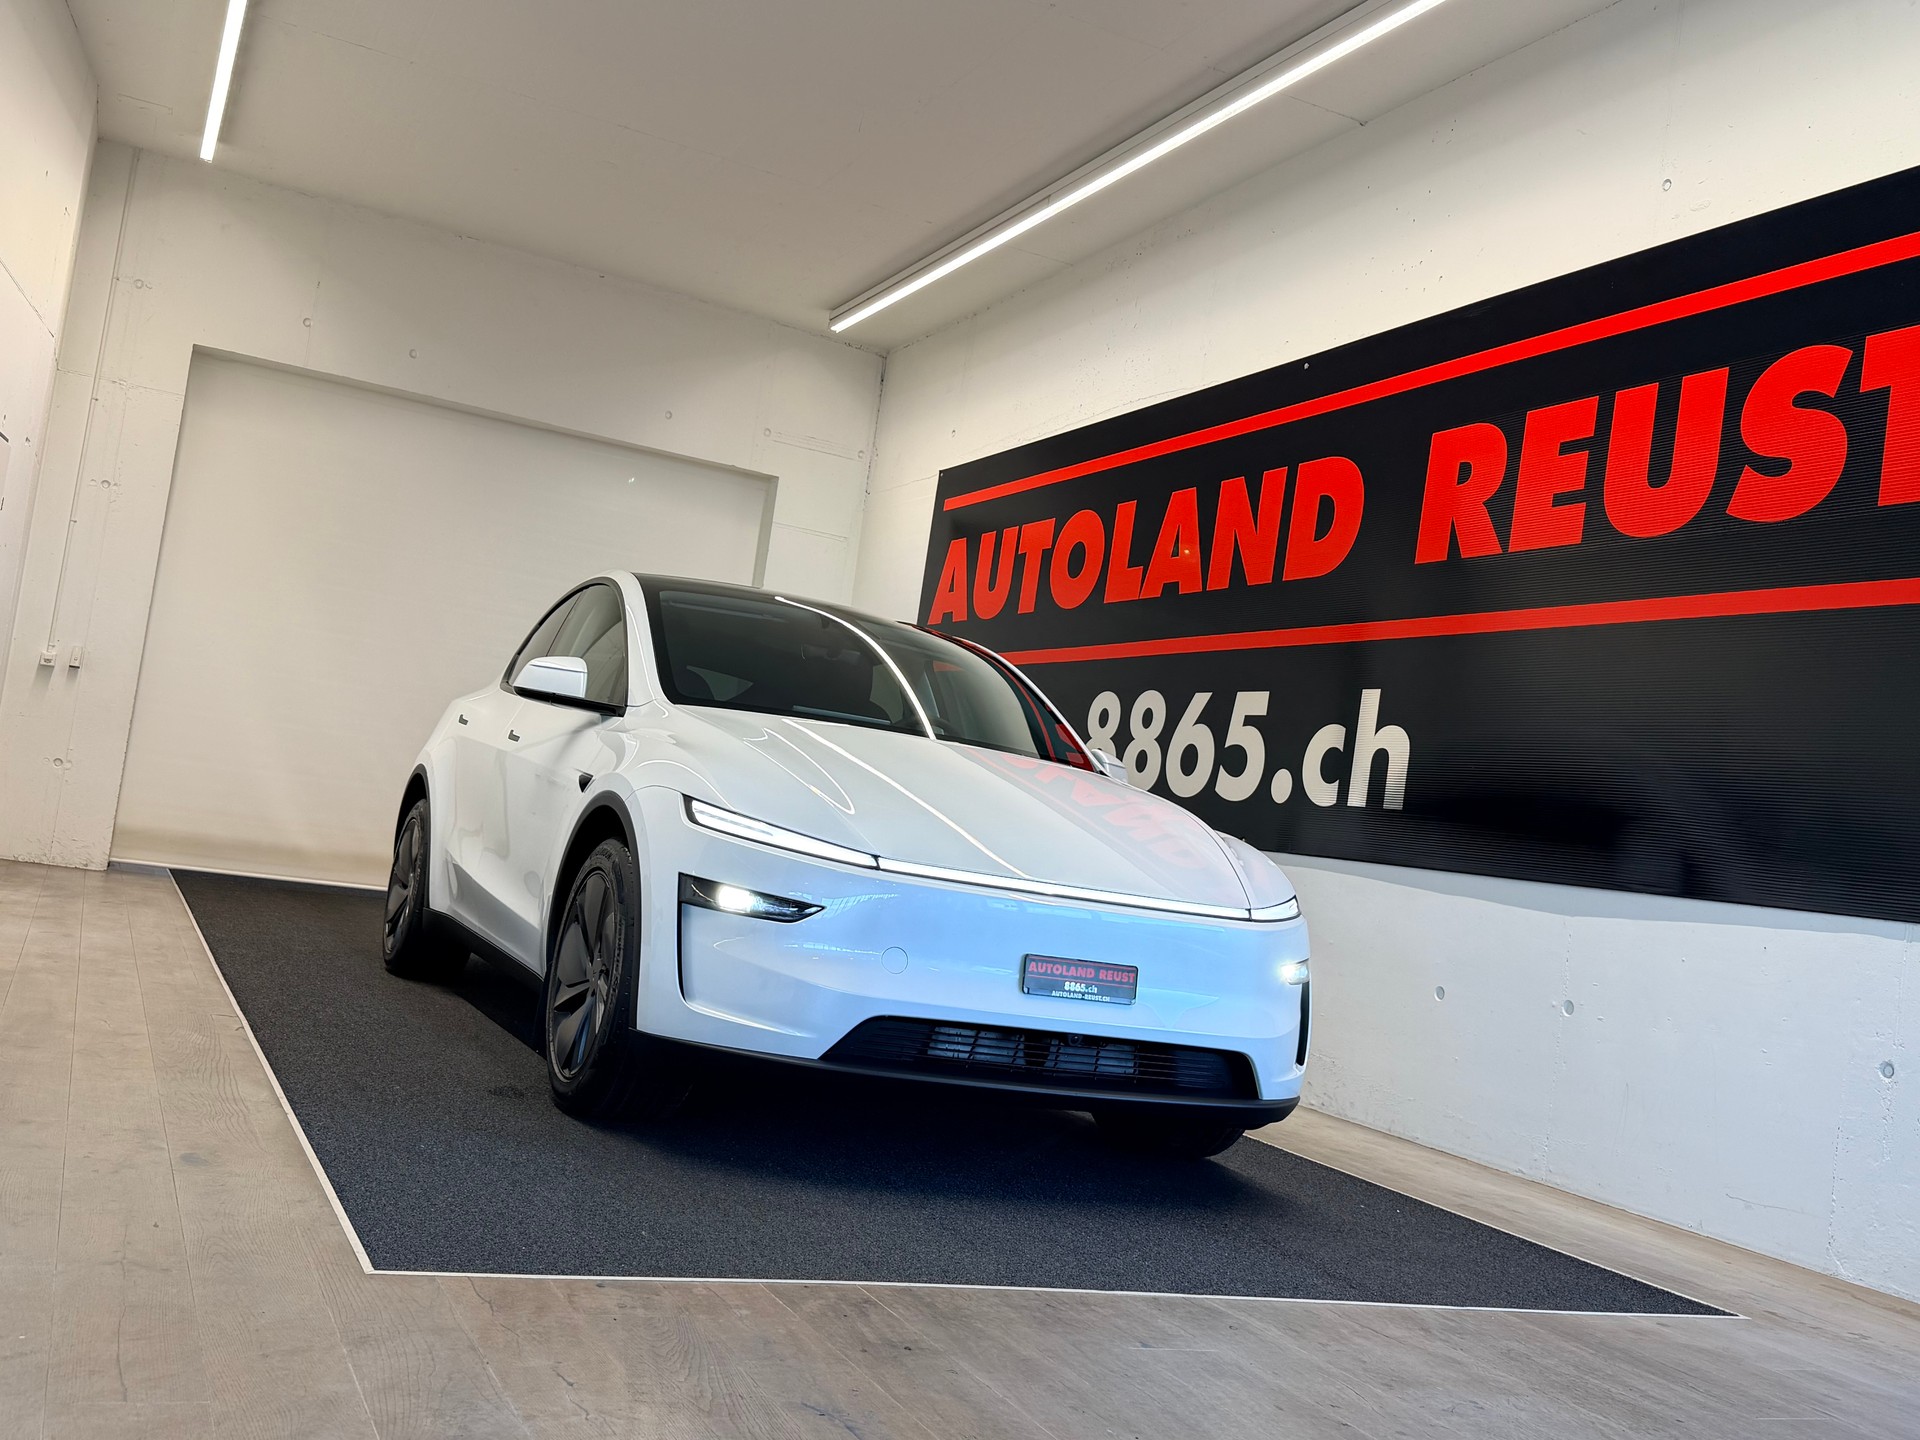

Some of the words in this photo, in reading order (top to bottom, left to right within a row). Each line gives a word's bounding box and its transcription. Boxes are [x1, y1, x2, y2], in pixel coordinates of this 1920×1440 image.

[927, 456, 1365, 626] AUTOLAND
[1086, 688, 1411, 811] 8865.ch
[1028, 961, 1096, 979] AUTOLAND
[1098, 969, 1136, 984] REUST
[1063, 981, 1098, 994] 8865.ch
